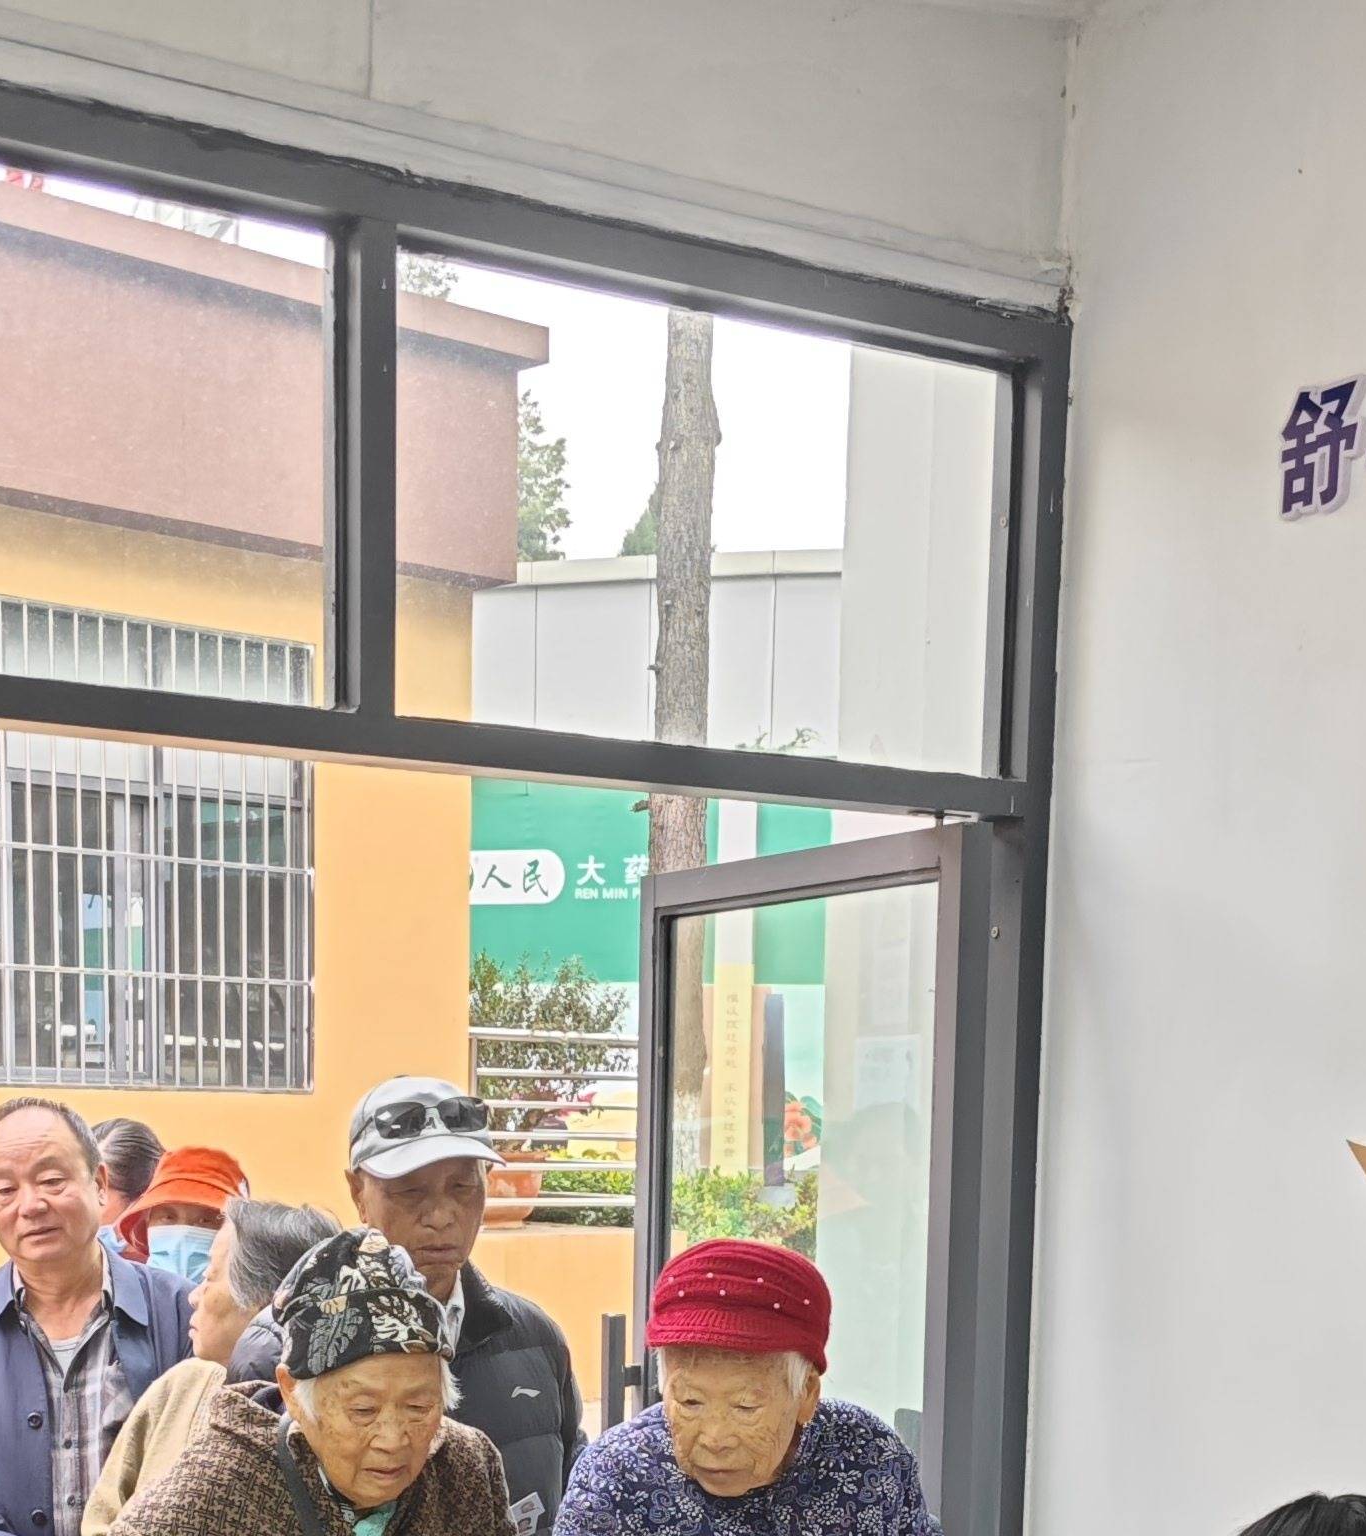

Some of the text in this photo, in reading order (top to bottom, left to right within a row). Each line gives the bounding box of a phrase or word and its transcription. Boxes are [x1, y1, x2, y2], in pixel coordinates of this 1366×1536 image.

[482, 859, 549, 897] 人民
[575, 887, 599, 900] REN
[602, 887, 628, 900] MIN
